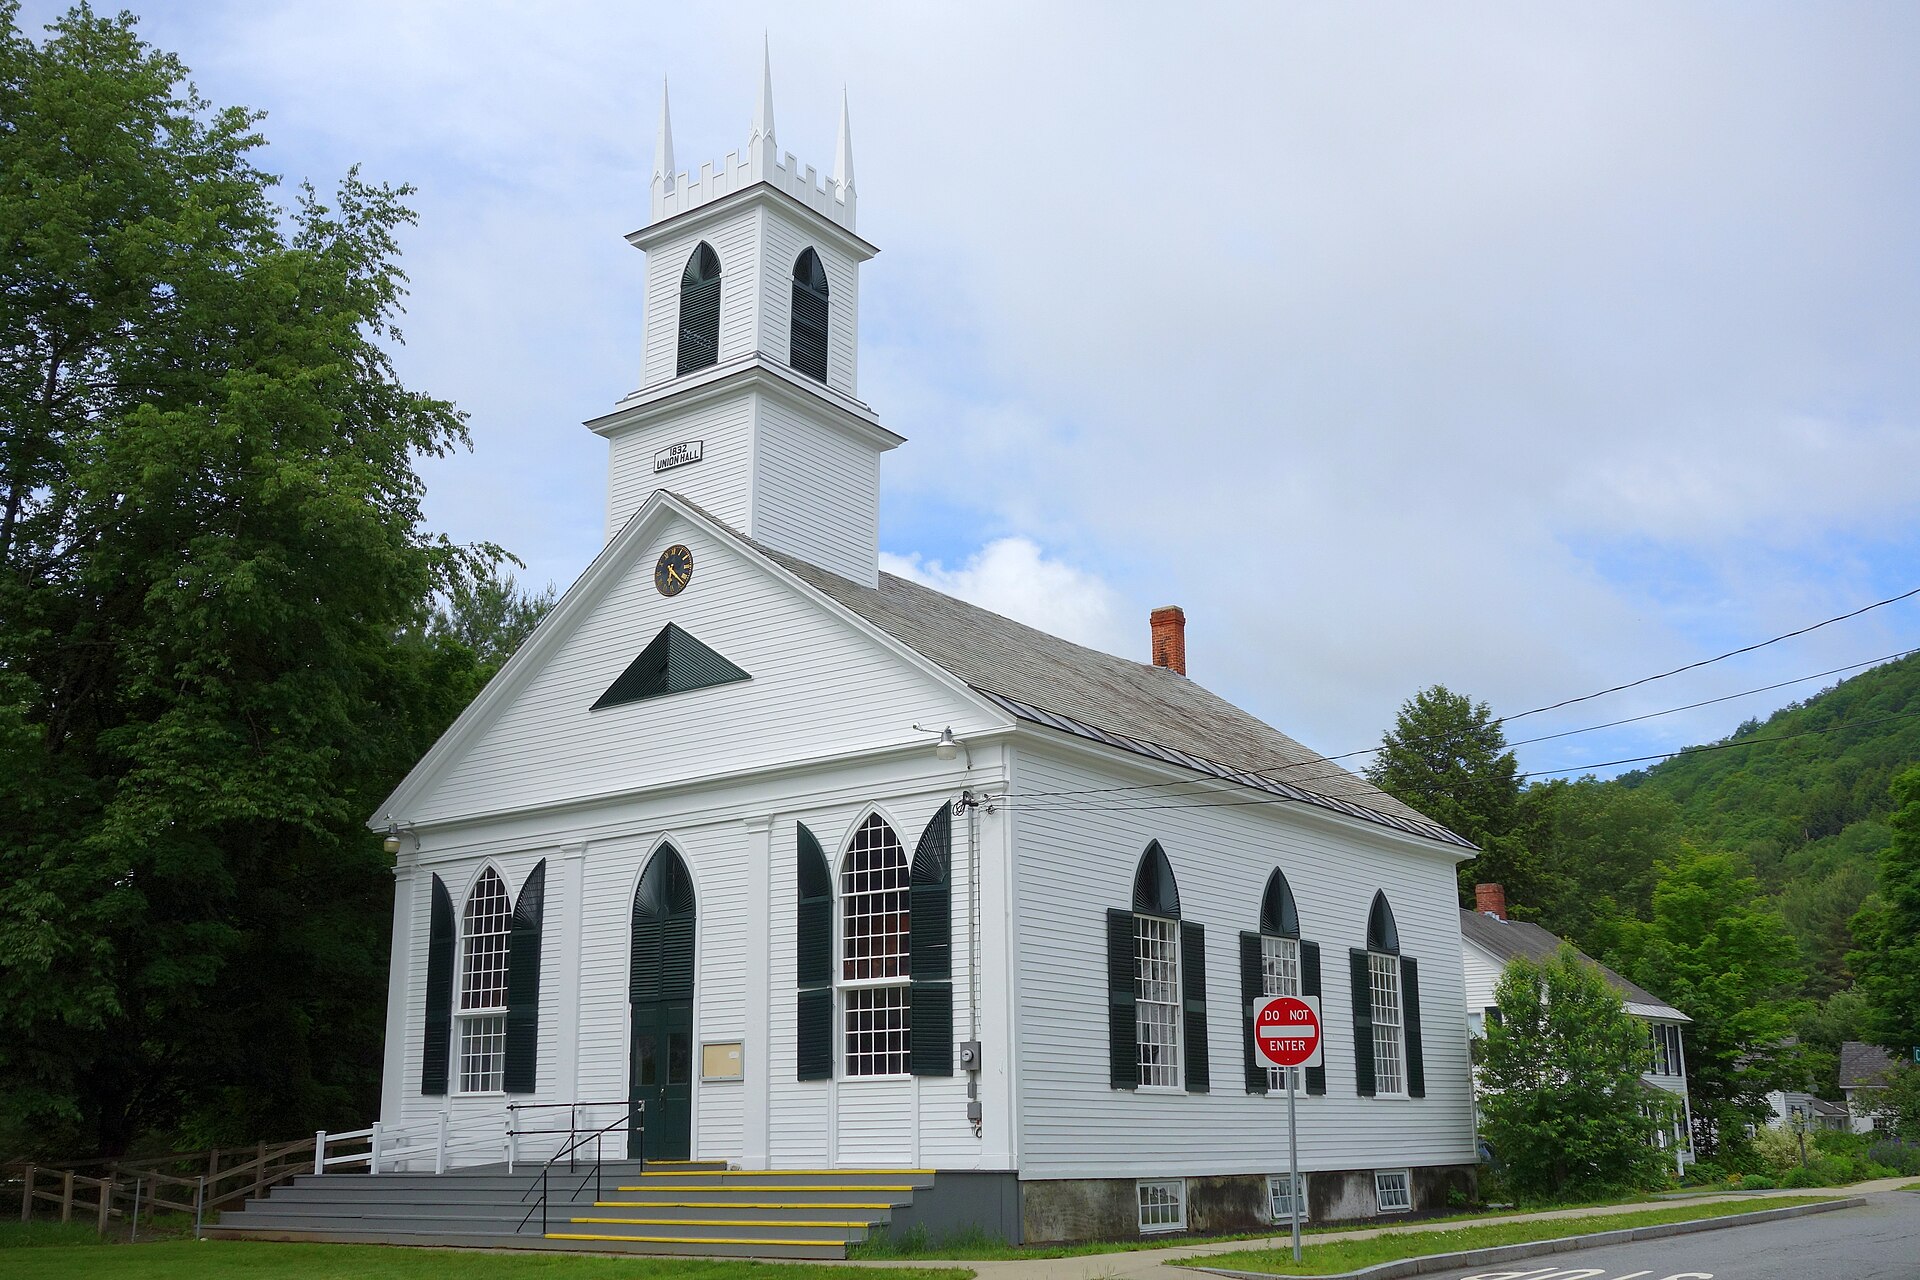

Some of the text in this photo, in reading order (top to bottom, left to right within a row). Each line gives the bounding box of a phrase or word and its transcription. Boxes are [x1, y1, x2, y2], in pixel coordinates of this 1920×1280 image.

[669, 444, 688, 457] 1832
[656, 450, 699, 469] UNION HALL
[1264, 1009, 1309, 1021] DO NOT
[1269, 1040, 1306, 1051] ENTER
